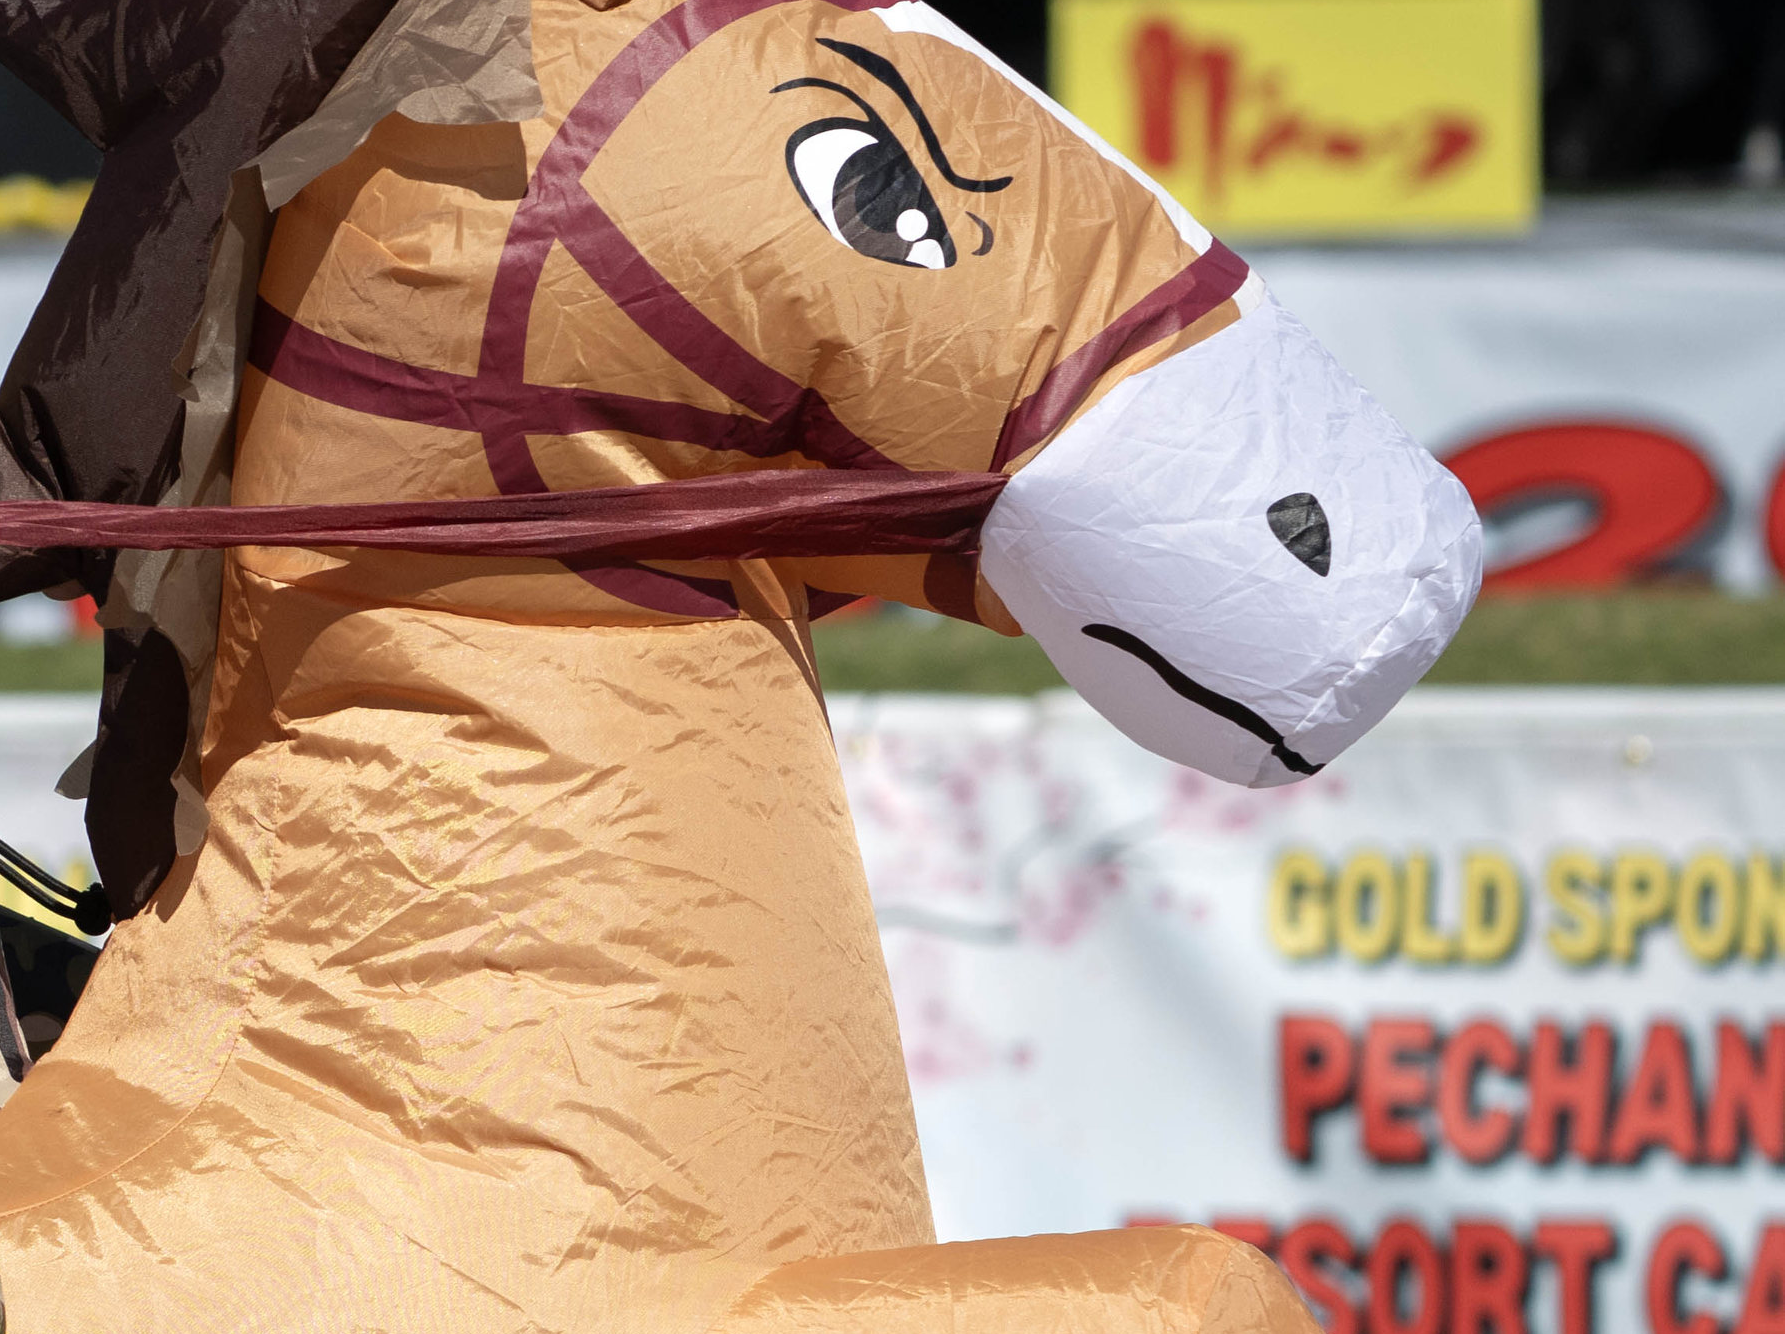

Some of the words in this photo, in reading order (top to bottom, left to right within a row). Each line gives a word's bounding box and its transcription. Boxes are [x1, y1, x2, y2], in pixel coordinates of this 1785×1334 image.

[1269, 849, 1523, 964] GOLD
[1547, 849, 1785, 965] SPON
[1280, 1014, 1785, 1164] PECHAN
